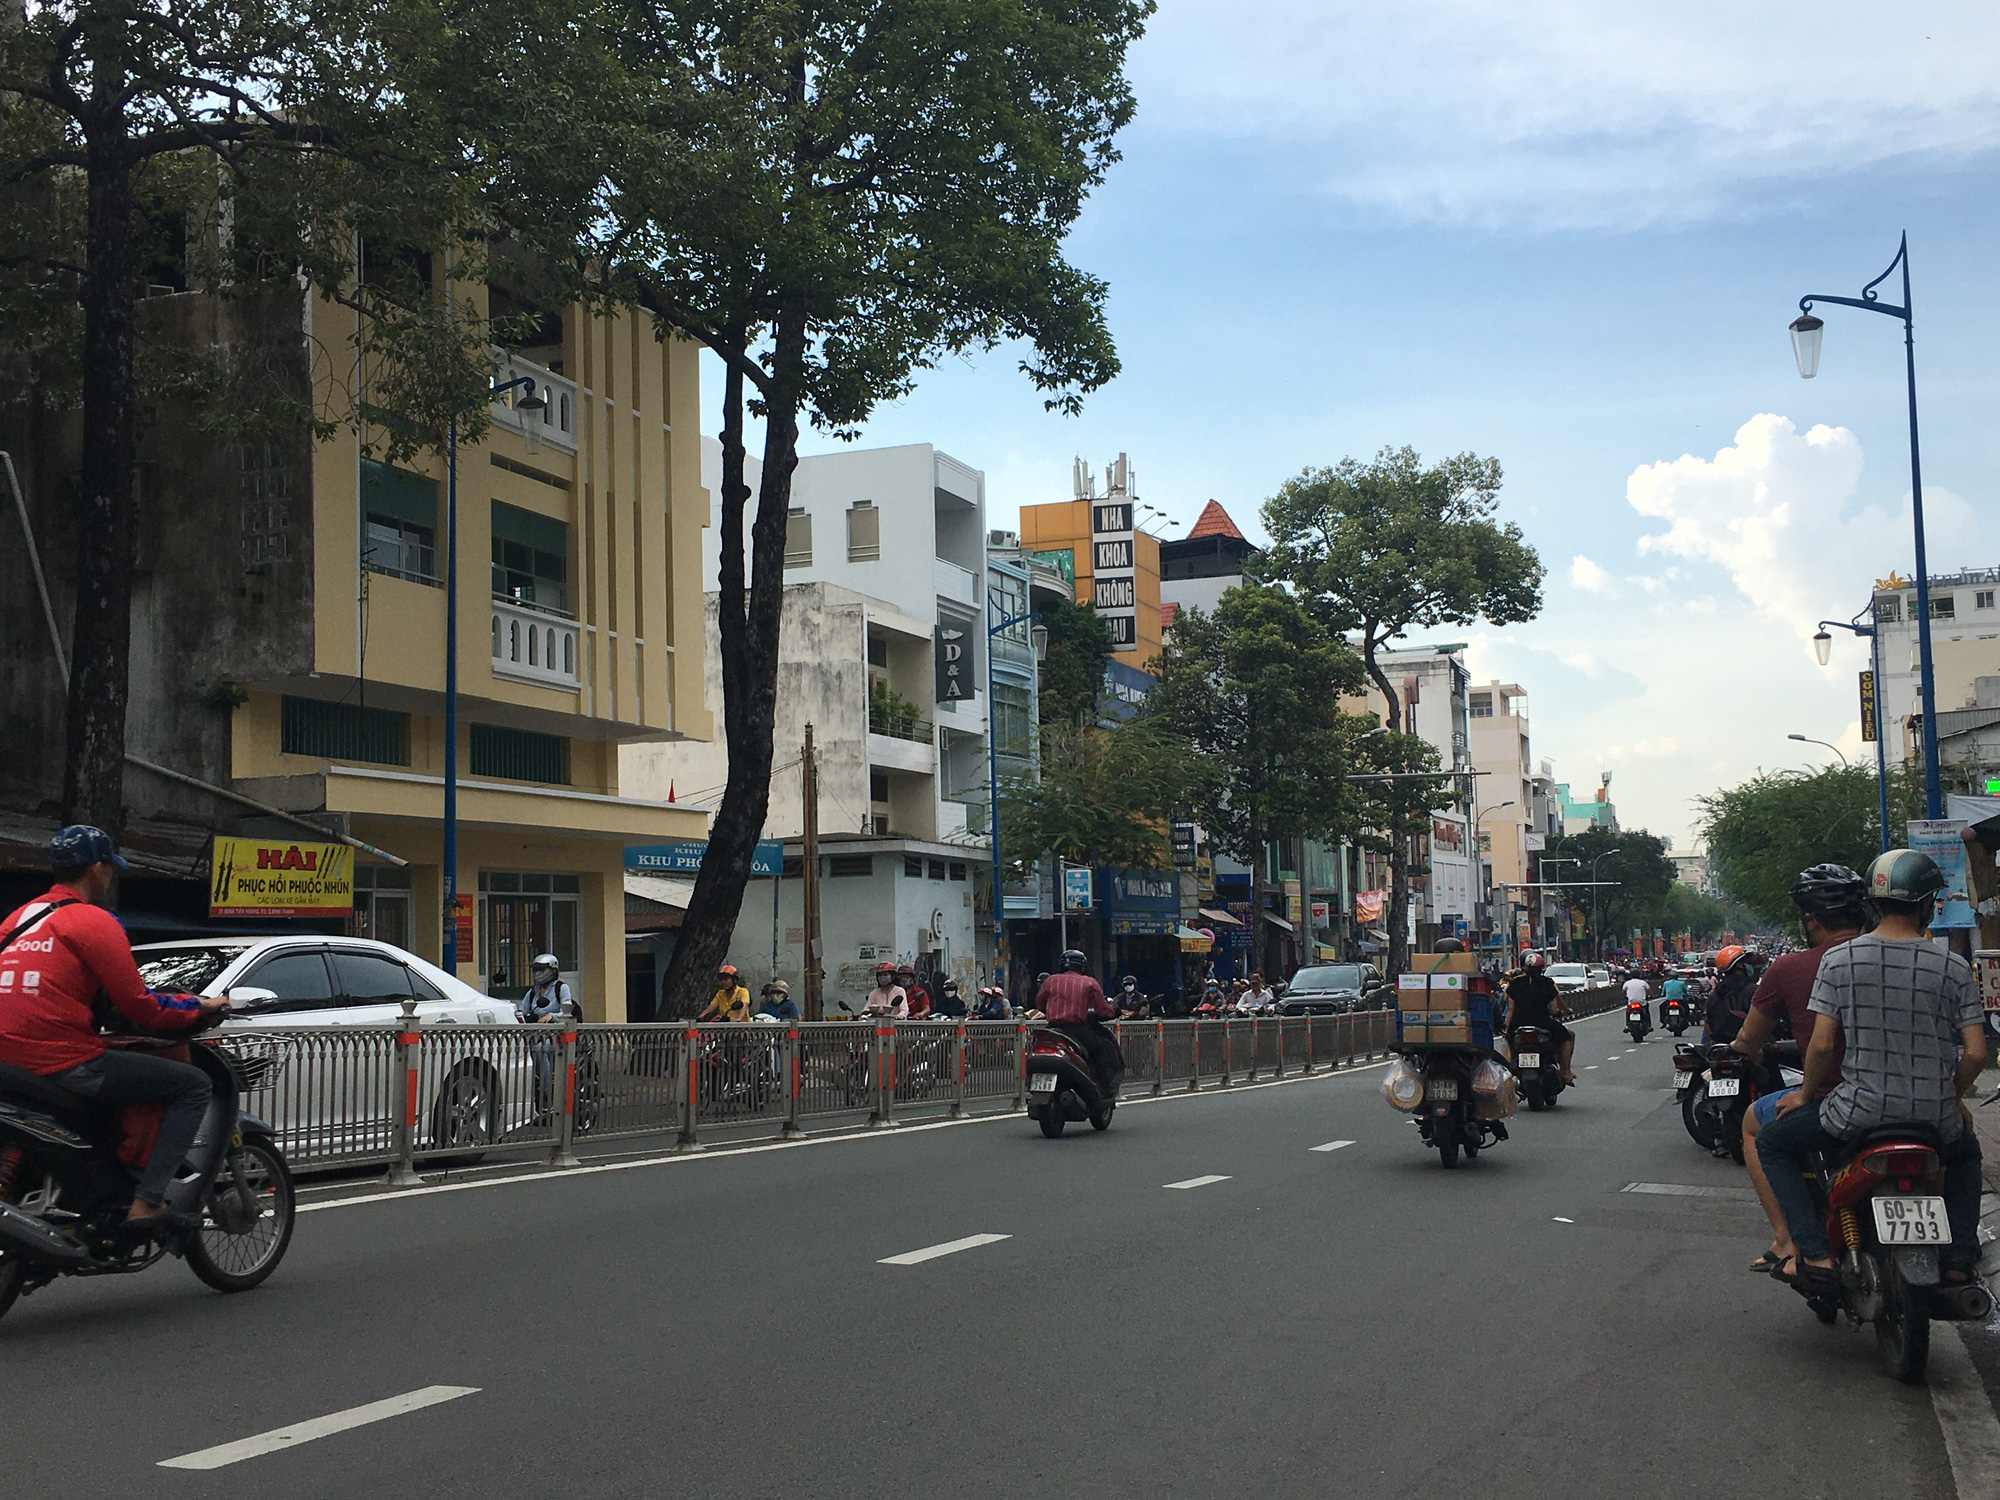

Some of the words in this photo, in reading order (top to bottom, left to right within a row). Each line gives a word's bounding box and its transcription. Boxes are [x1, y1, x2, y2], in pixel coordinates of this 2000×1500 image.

[1101, 507, 1124, 531] NHA
[1098, 542, 1128, 568] KHOA
[1096, 579, 1133, 607] KHÔNG
[1863, 673, 1874, 698] CƠM
[256, 845, 317, 872] HẢI
[637, 854, 671, 867] KHU
[238, 878, 265, 897] PHỤC
[323, 878, 349, 894] NHÚN
[1714, 1080, 1735, 1088] 59-K2
[1883, 1200, 1936, 1220] 60-T4
[1887, 1221, 1940, 1241] 7793
